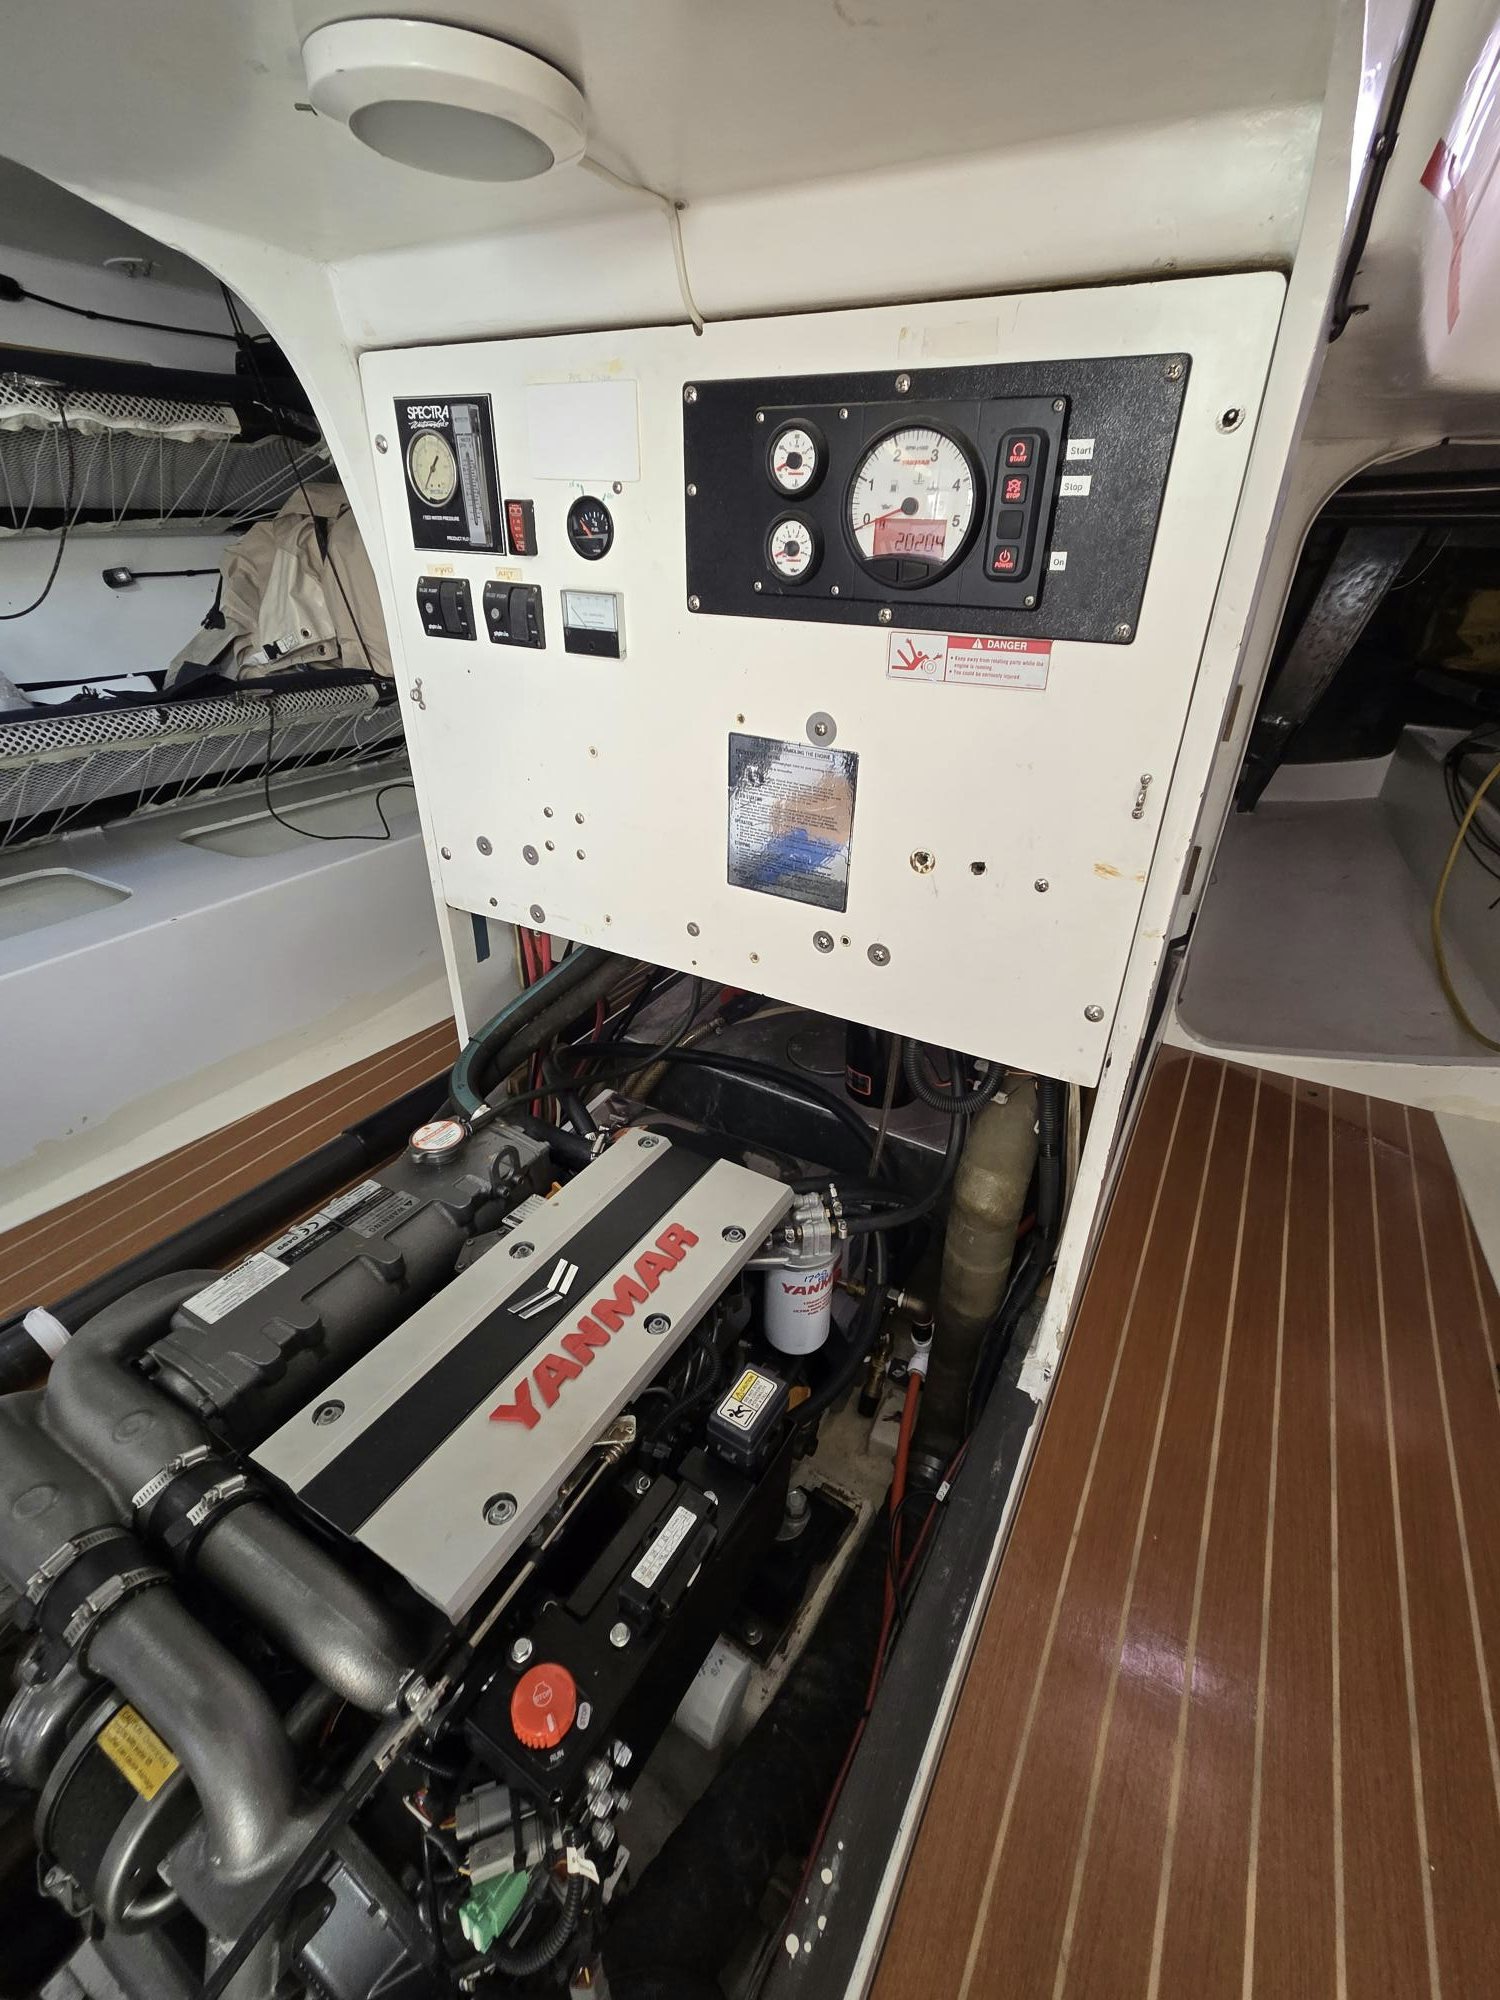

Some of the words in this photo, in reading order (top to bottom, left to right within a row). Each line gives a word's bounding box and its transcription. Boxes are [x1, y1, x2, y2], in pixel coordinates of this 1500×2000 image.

[407, 405, 449, 422] SPECTRA
[893, 450, 901, 462] 2
[931, 449, 939, 462] 3
[1071, 446, 1092, 456] Start
[952, 479, 961, 491] 4
[952, 515, 960, 527] 5
[1053, 558, 1065, 566] On
[987, 640, 1028, 651] DANGER
[368, 1204, 408, 1233] WARNING
[489, 1222, 699, 1430] YANMAR
[549, 1748, 564, 1762] RUN
